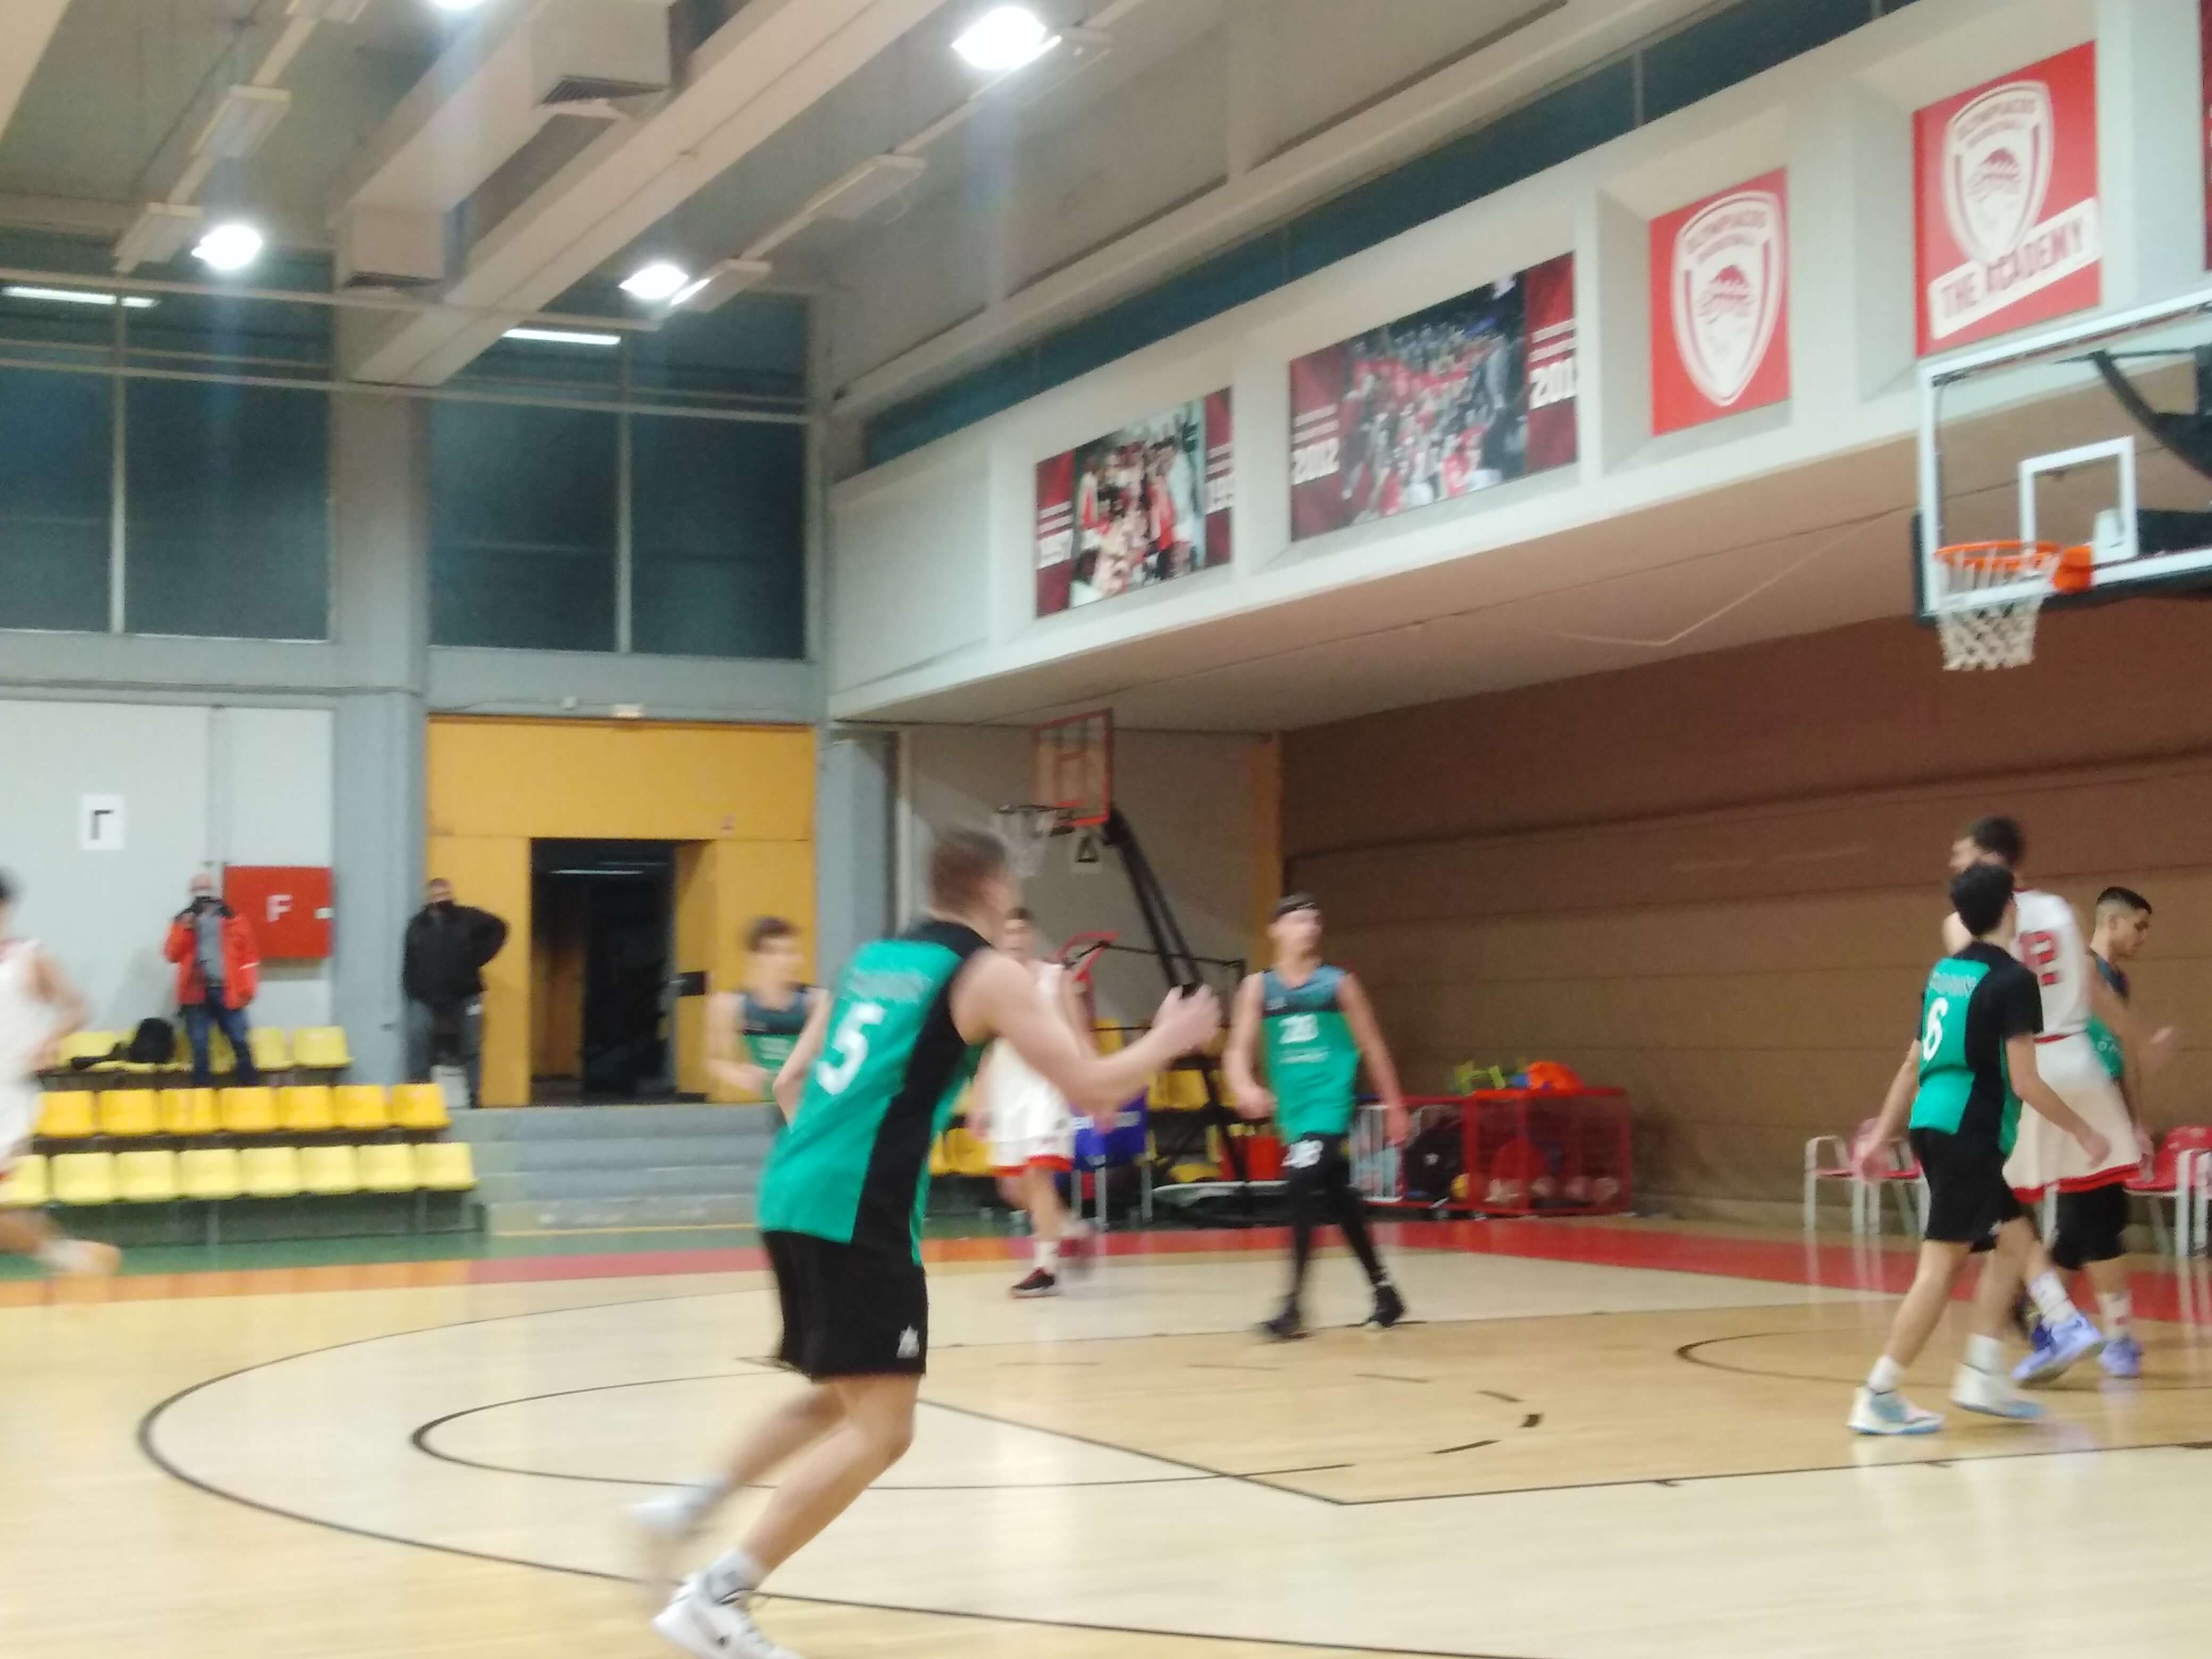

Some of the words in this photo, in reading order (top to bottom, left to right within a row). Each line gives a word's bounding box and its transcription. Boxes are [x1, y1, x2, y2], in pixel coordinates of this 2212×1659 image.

[1941, 271, 1978, 320] THE
[267, 894, 293, 923] F
[816, 1002, 888, 1096] 5
[1922, 996, 1949, 1061] 6
